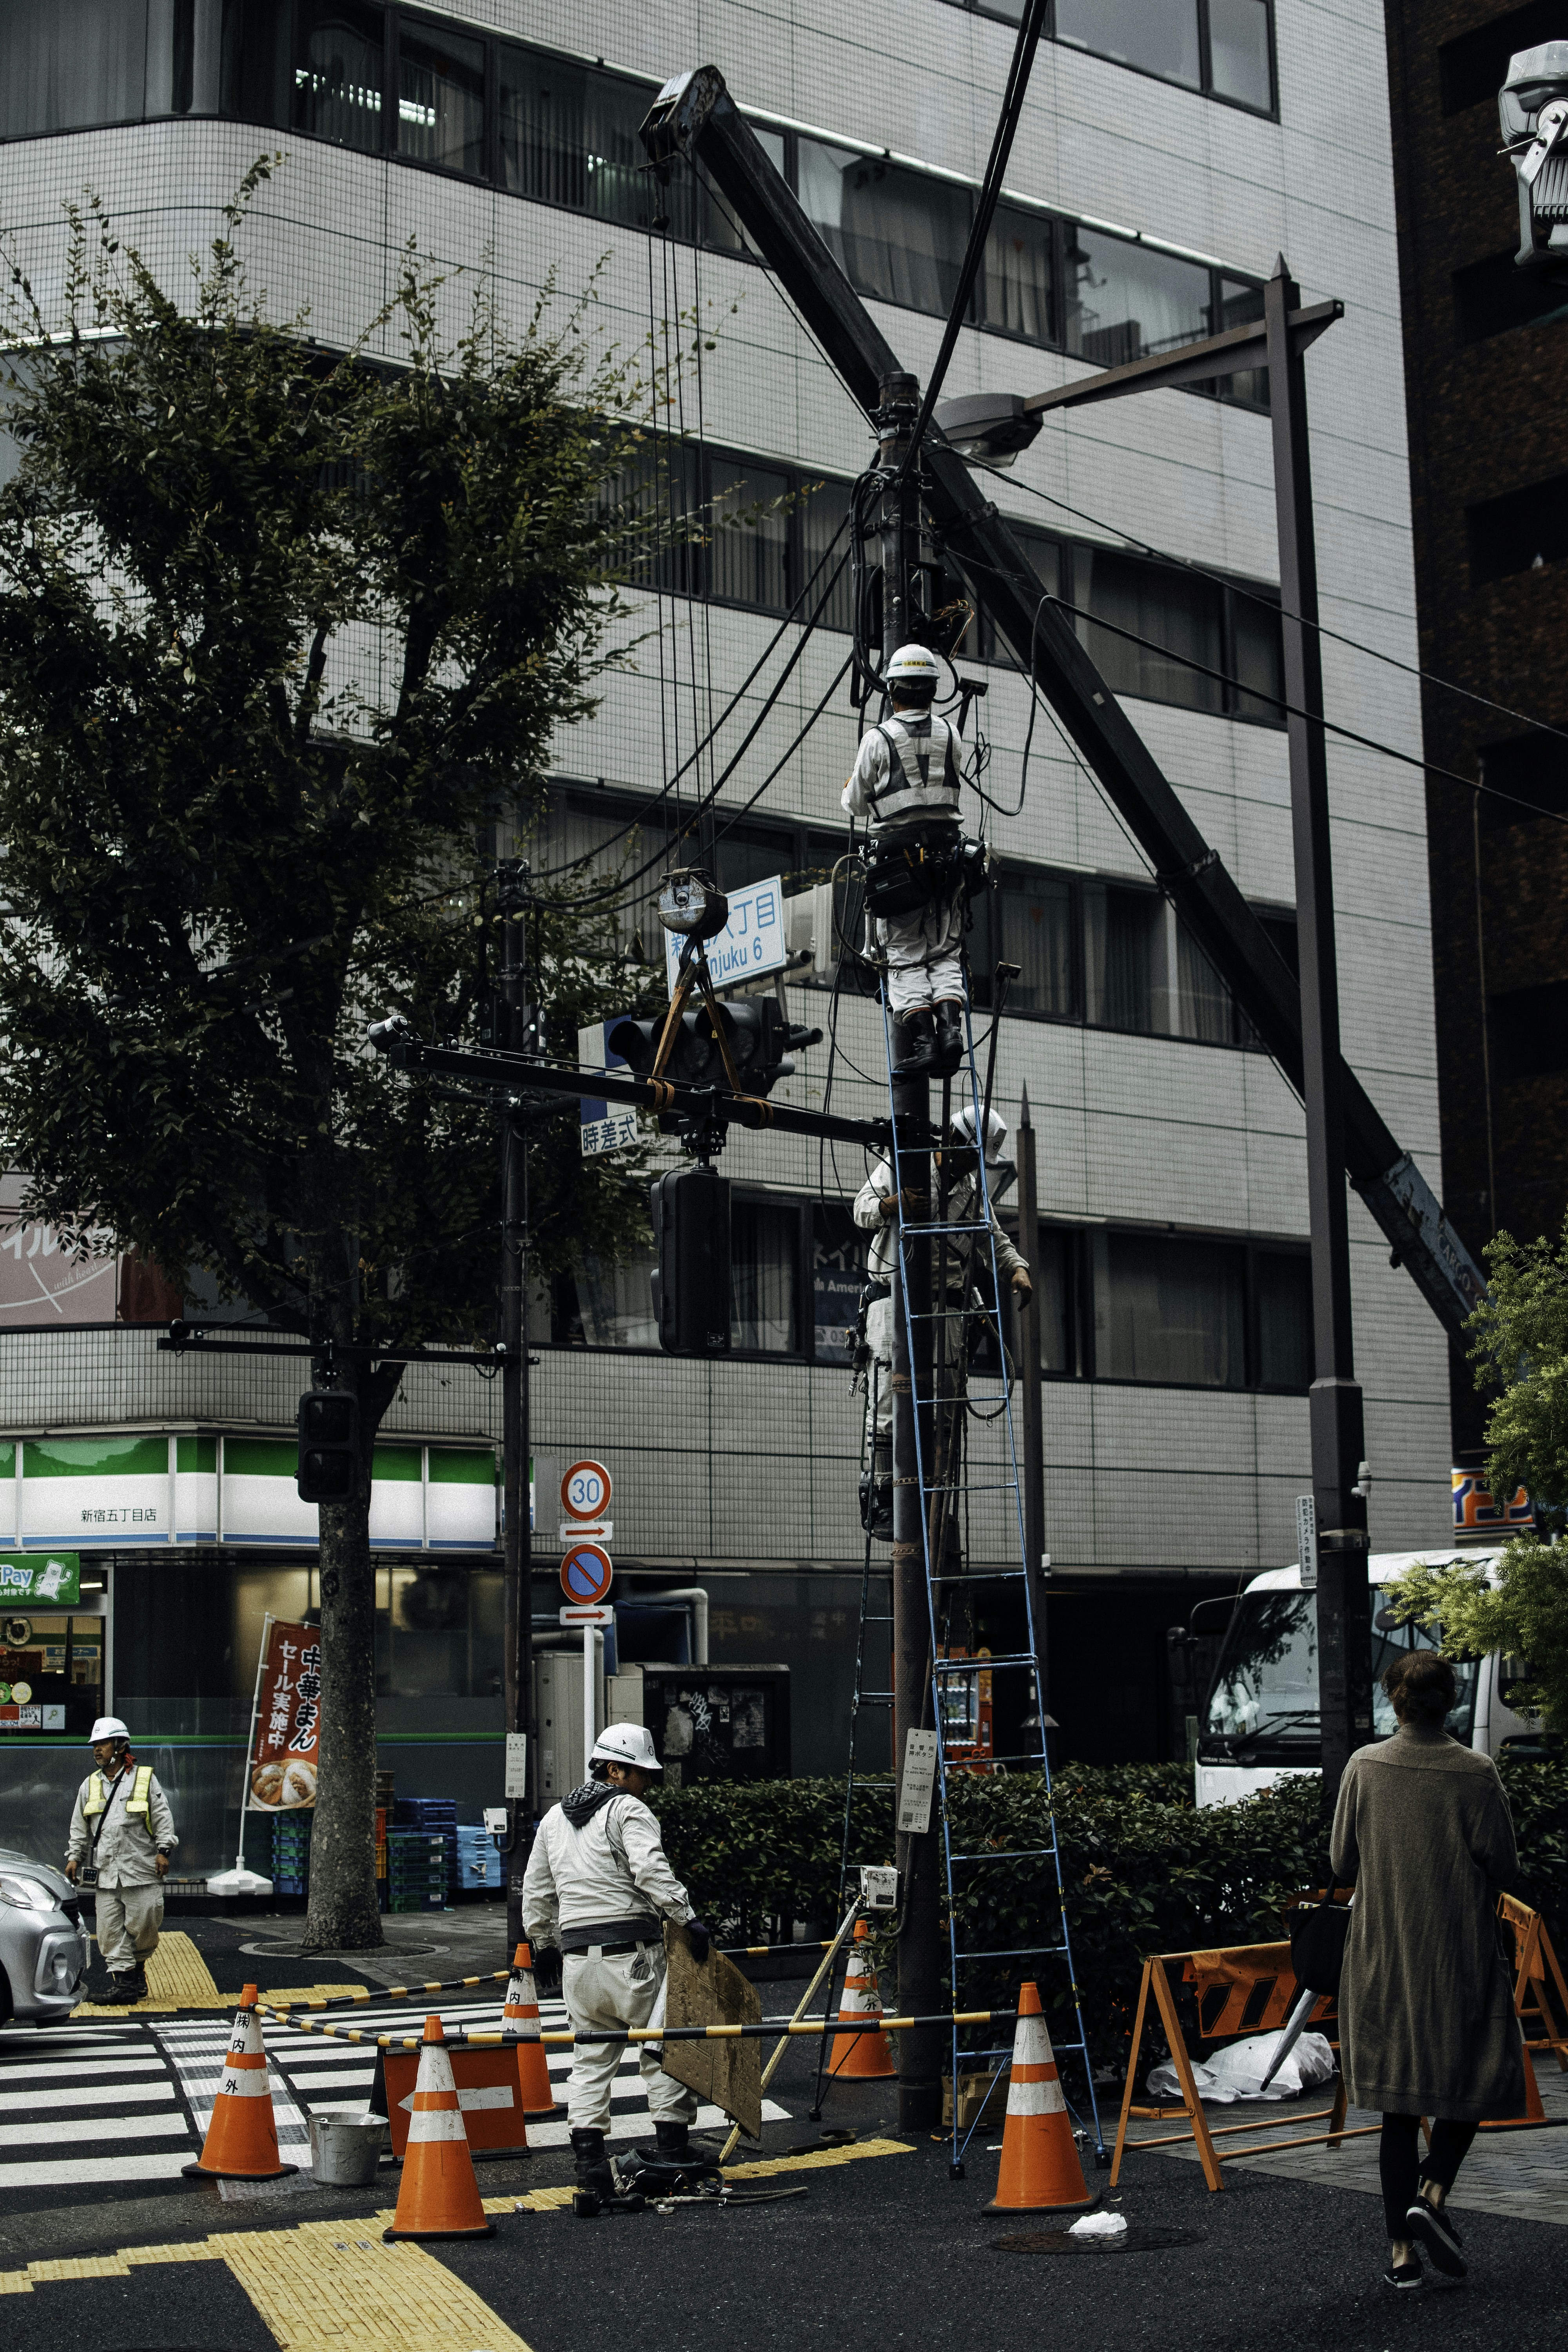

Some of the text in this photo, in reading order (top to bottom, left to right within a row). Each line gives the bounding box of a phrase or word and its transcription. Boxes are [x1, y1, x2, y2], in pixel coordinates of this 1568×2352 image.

[753, 936, 763, 960] 6
[582, 1115, 636, 1153] 時差式
[1437, 1234, 1472, 1292] CARGO
[572, 1478, 600, 1504] 30
[80, 1508, 157, 1523] 新宿五丁目店
[1301, 1499, 1311, 1573] 防犯カメラ作動中
[268, 1640, 298, 1750] セール実施中
[289, 1643, 321, 1752] 中華まん
[908, 1750, 934, 1758] 押ボタン
